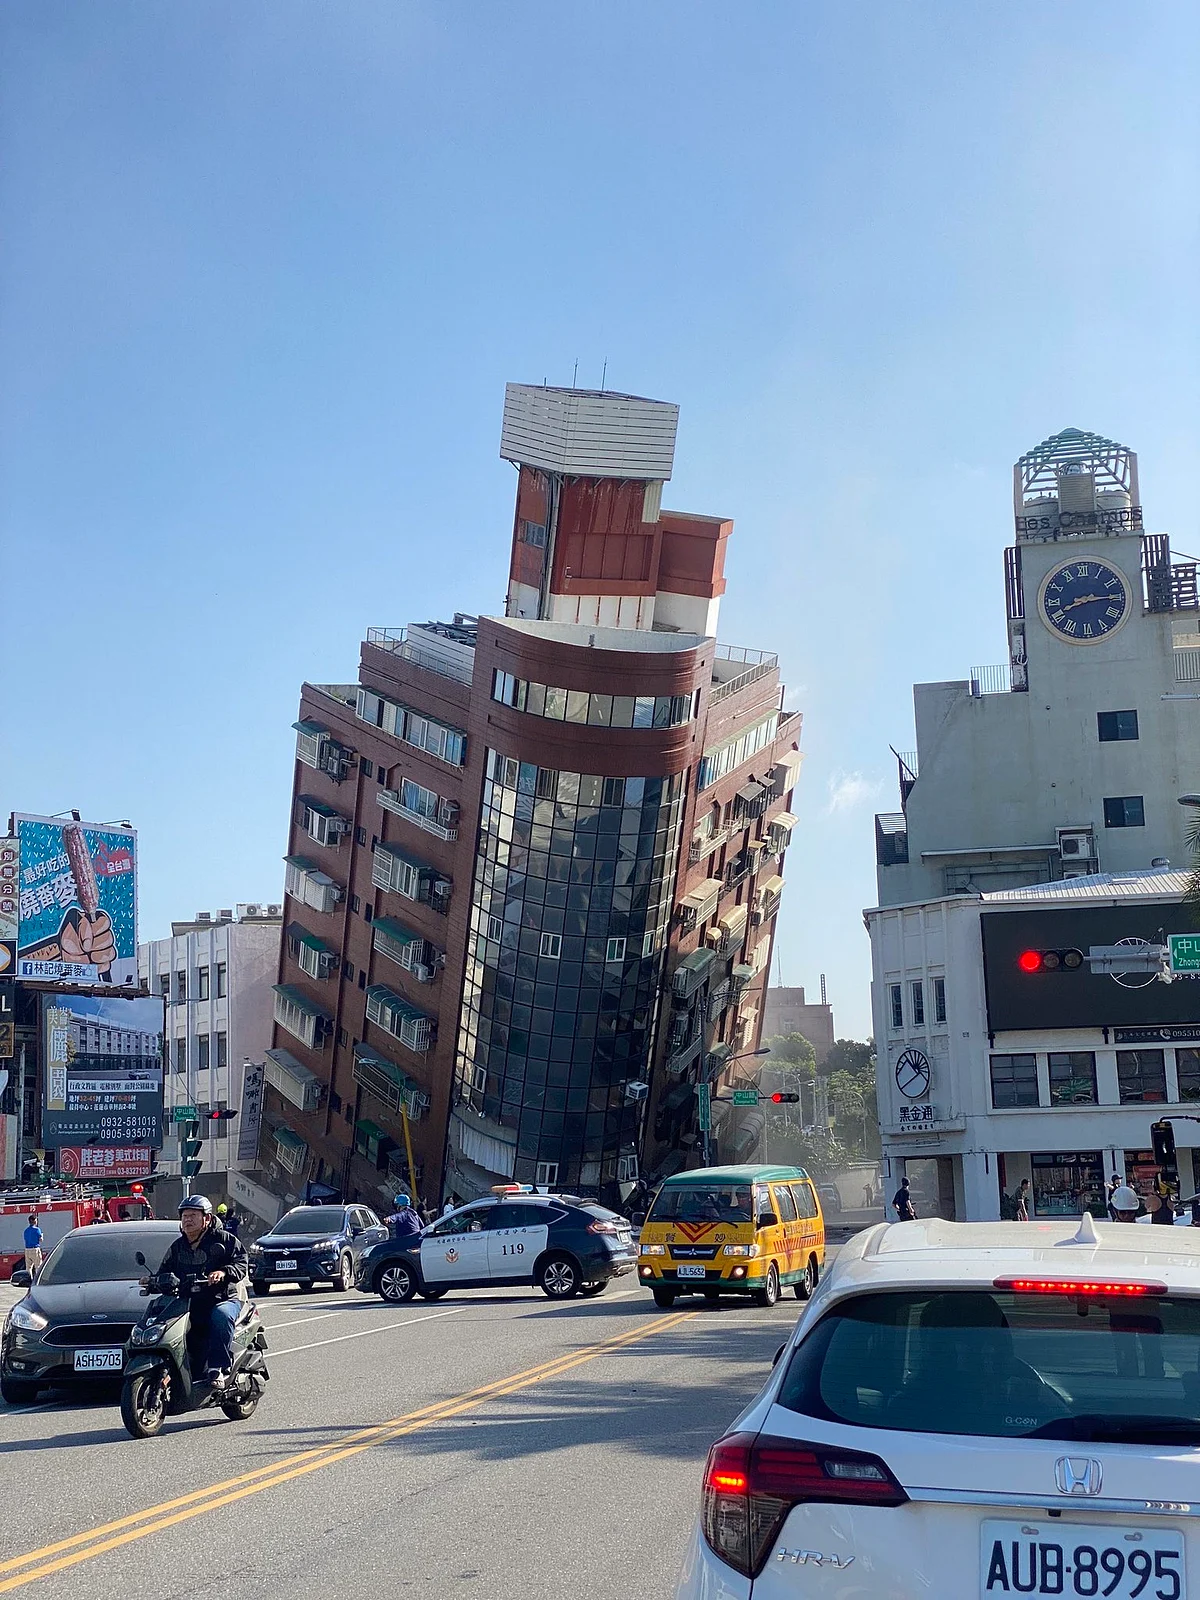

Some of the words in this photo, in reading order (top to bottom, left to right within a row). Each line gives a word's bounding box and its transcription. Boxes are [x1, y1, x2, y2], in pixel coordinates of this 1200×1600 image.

[23, 852, 71, 885] 最好吃的
[107, 858, 131, 874] 全台灣
[101, 1116, 156, 1127] 0932-581018
[900, 1105, 933, 1122] 黑金通
[100, 1128, 156, 1139] 0905-935071
[81, 1149, 114, 1167] 胖老爹
[115, 1148, 149, 1161] 美式炸雞
[502, 1243, 524, 1255] 119
[76, 1354, 121, 1368] ASH-5703
[777, 1547, 856, 1569] HR-V
[986, 1540, 1181, 1600] AUB-8995
